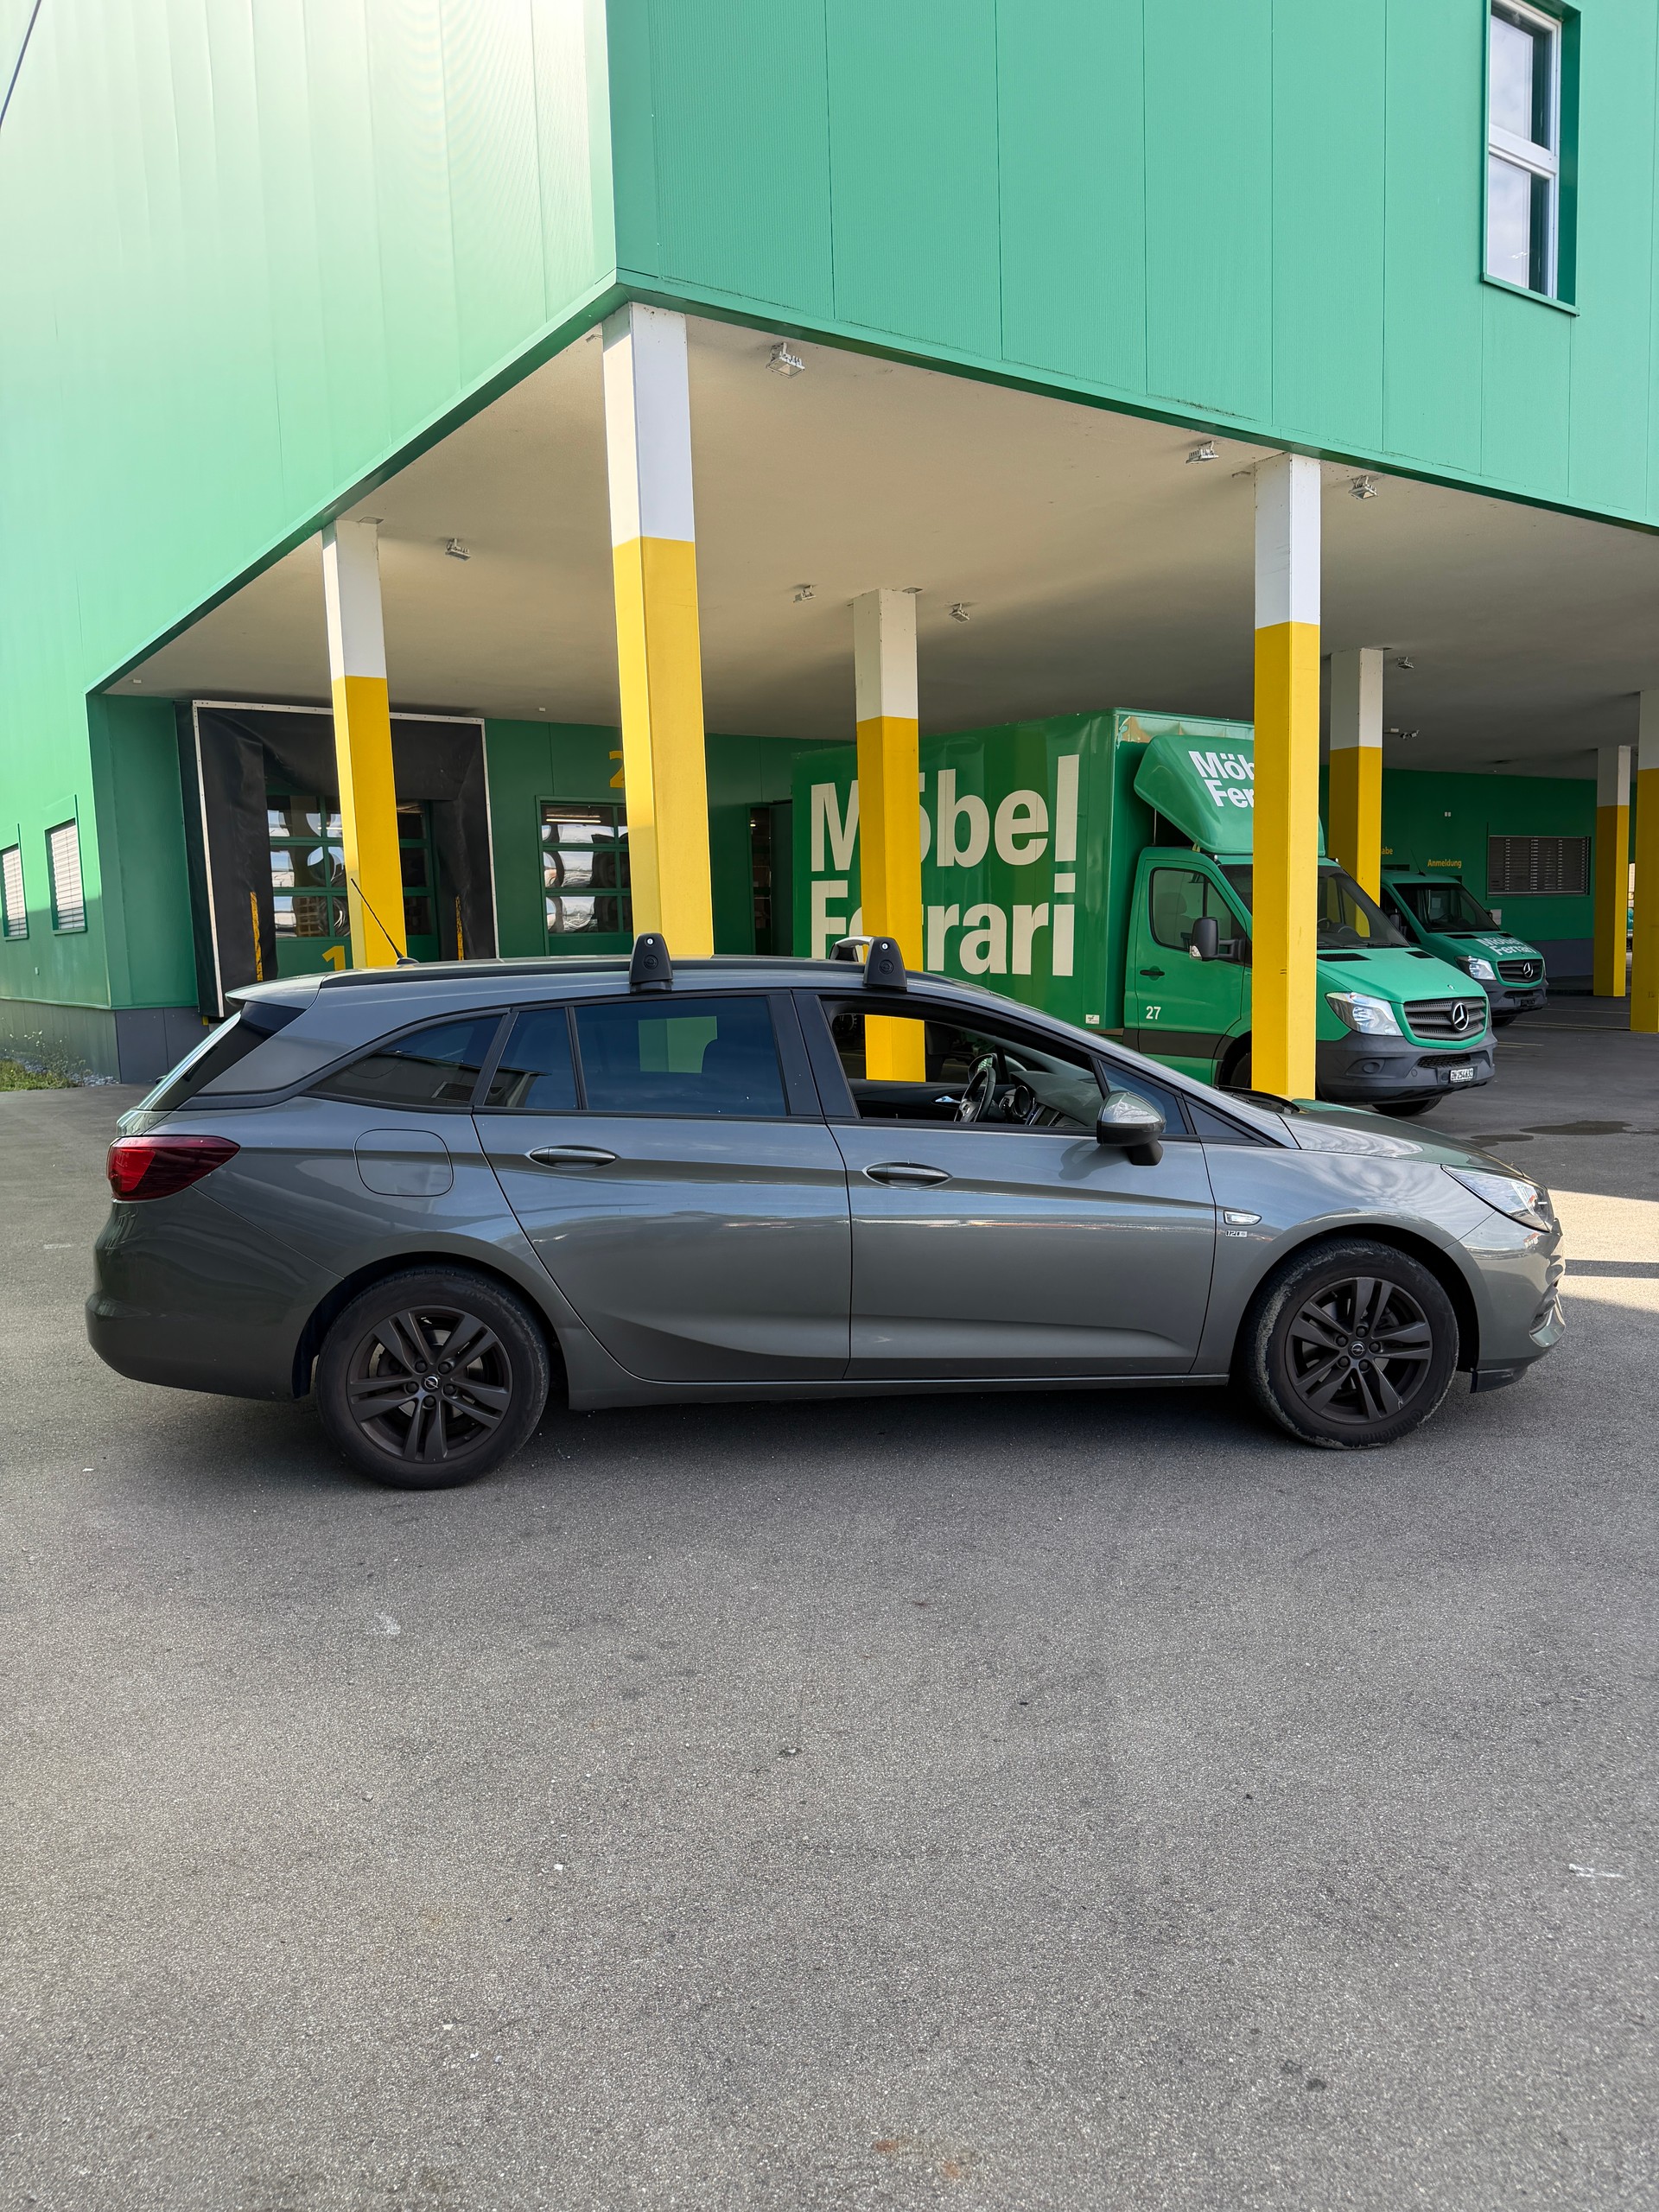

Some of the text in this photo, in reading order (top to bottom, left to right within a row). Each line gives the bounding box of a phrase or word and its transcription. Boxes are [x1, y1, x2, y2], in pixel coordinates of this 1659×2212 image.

[1427, 859, 1462, 868] Anmeldung
[810, 873, 1076, 976] Frari
[1489, 945, 1537, 956] Ferrari
[322, 945, 346, 972] 1
[1146, 1005, 1161, 1020] 27
